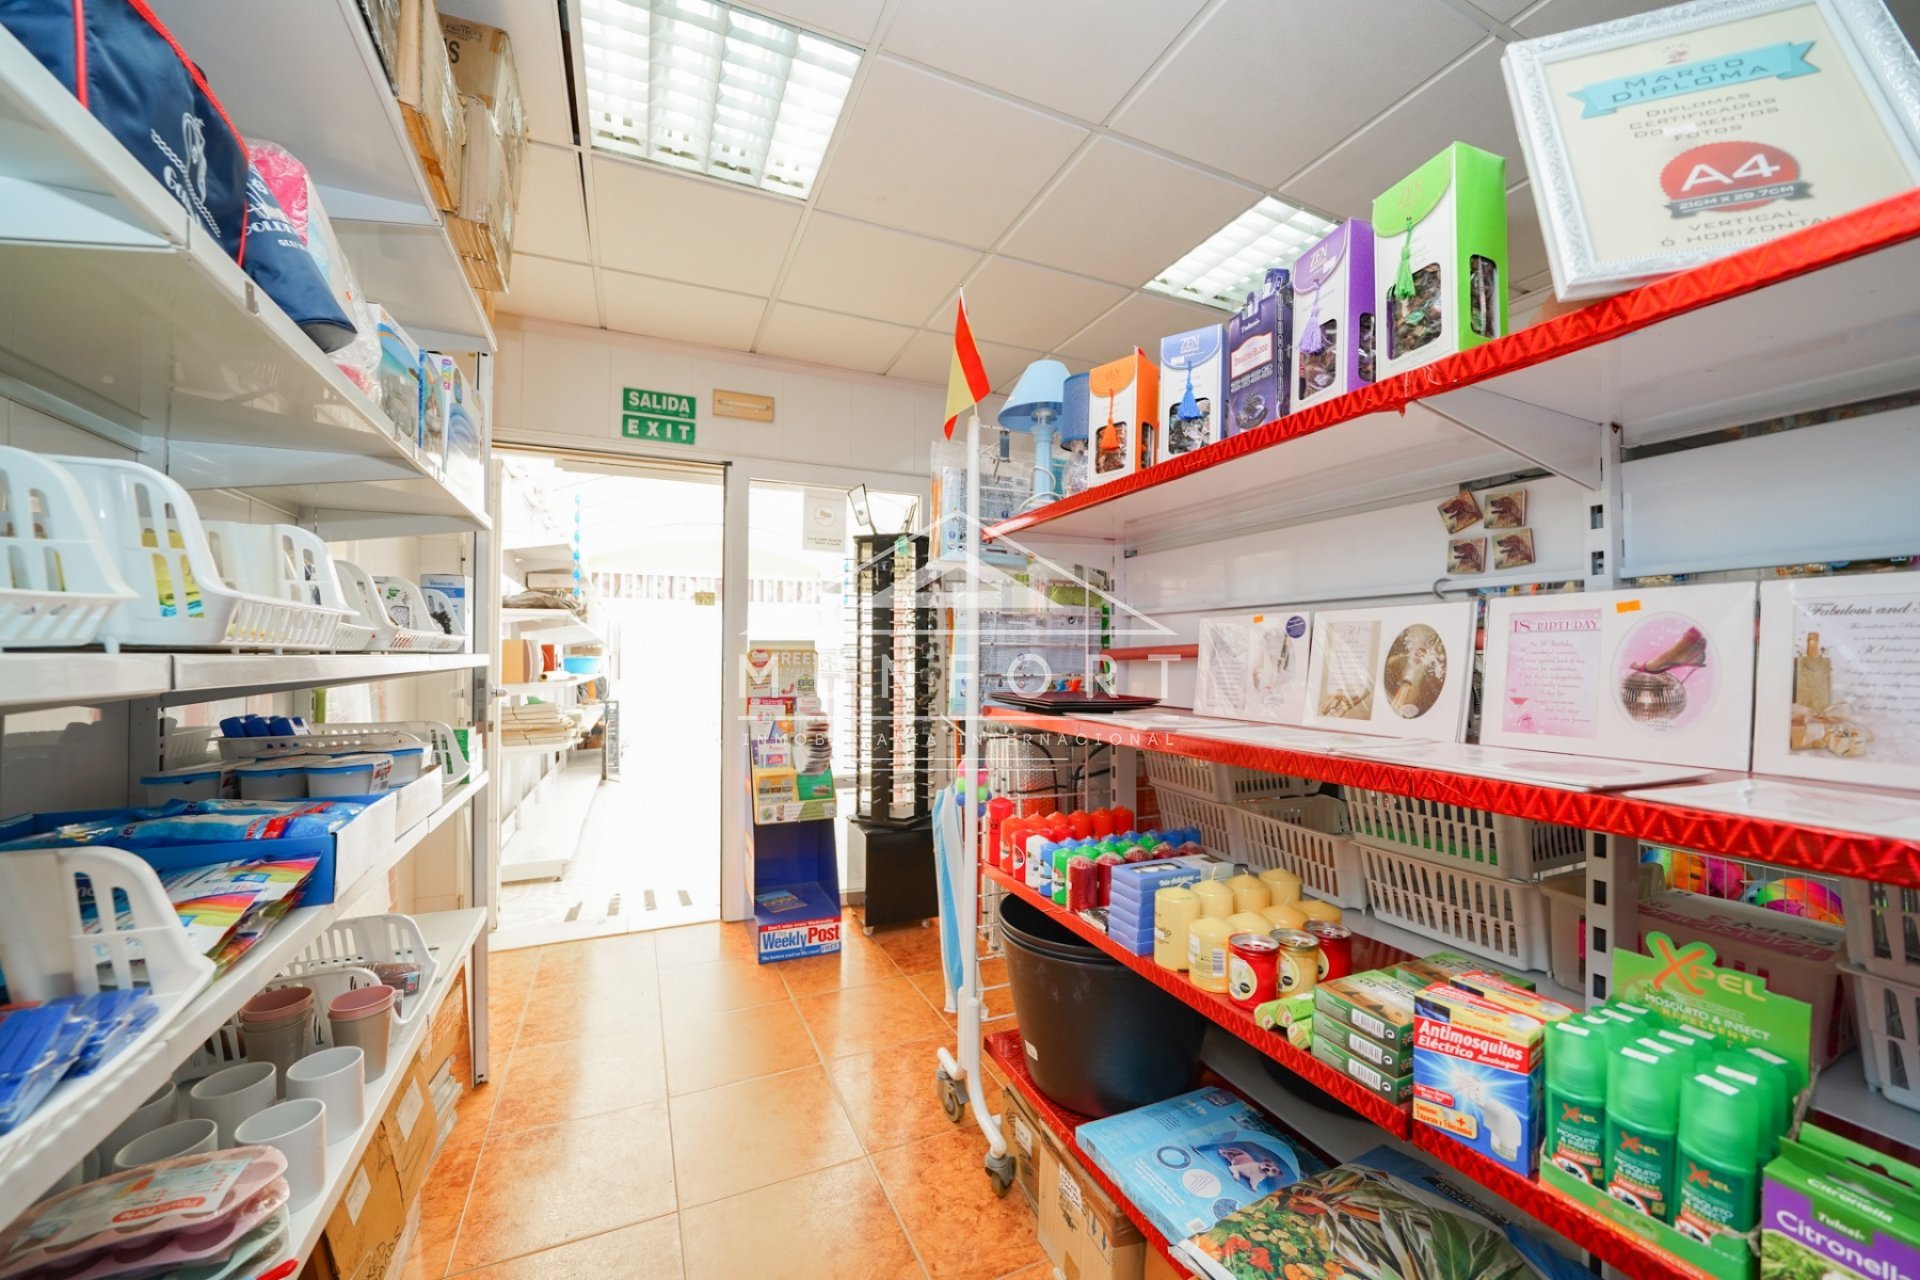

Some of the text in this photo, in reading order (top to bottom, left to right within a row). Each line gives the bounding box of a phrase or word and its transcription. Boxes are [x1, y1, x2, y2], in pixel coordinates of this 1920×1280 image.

[1612, 65, 1769, 103] DIPLOMA
[1624, 58, 1744, 89] MARCO
[1629, 97, 1777, 130] CERTIFICADOS
[1646, 92, 1751, 117] DIPLOMAS
[1633, 106, 1780, 139] DOMENTOS
[1674, 123, 1743, 141] FOTOS
[1680, 153, 1781, 193] A4
[1679, 197, 1713, 210] 21CM
[1686, 216, 1831, 243] HORIZONTA
[1688, 210, 1800, 231] VERTICAL
[628, 391, 691, 414] SALIDA
[627, 418, 691, 441] EXIT
[1806, 602, 1873, 617] Fabulous
[1875, 601, 1911, 615] and
[762, 924, 840, 953] Weekly Post
[1645, 993, 1710, 1021] MOSQUITO
[1711, 1014, 1722, 1025] &
[1723, 1019, 1771, 1041] INSECT
[1417, 1034, 1475, 1060] Eléctrico
[1418, 1020, 1524, 1061] Antimosquitos
[1775, 1209, 1916, 1280] Citronell
